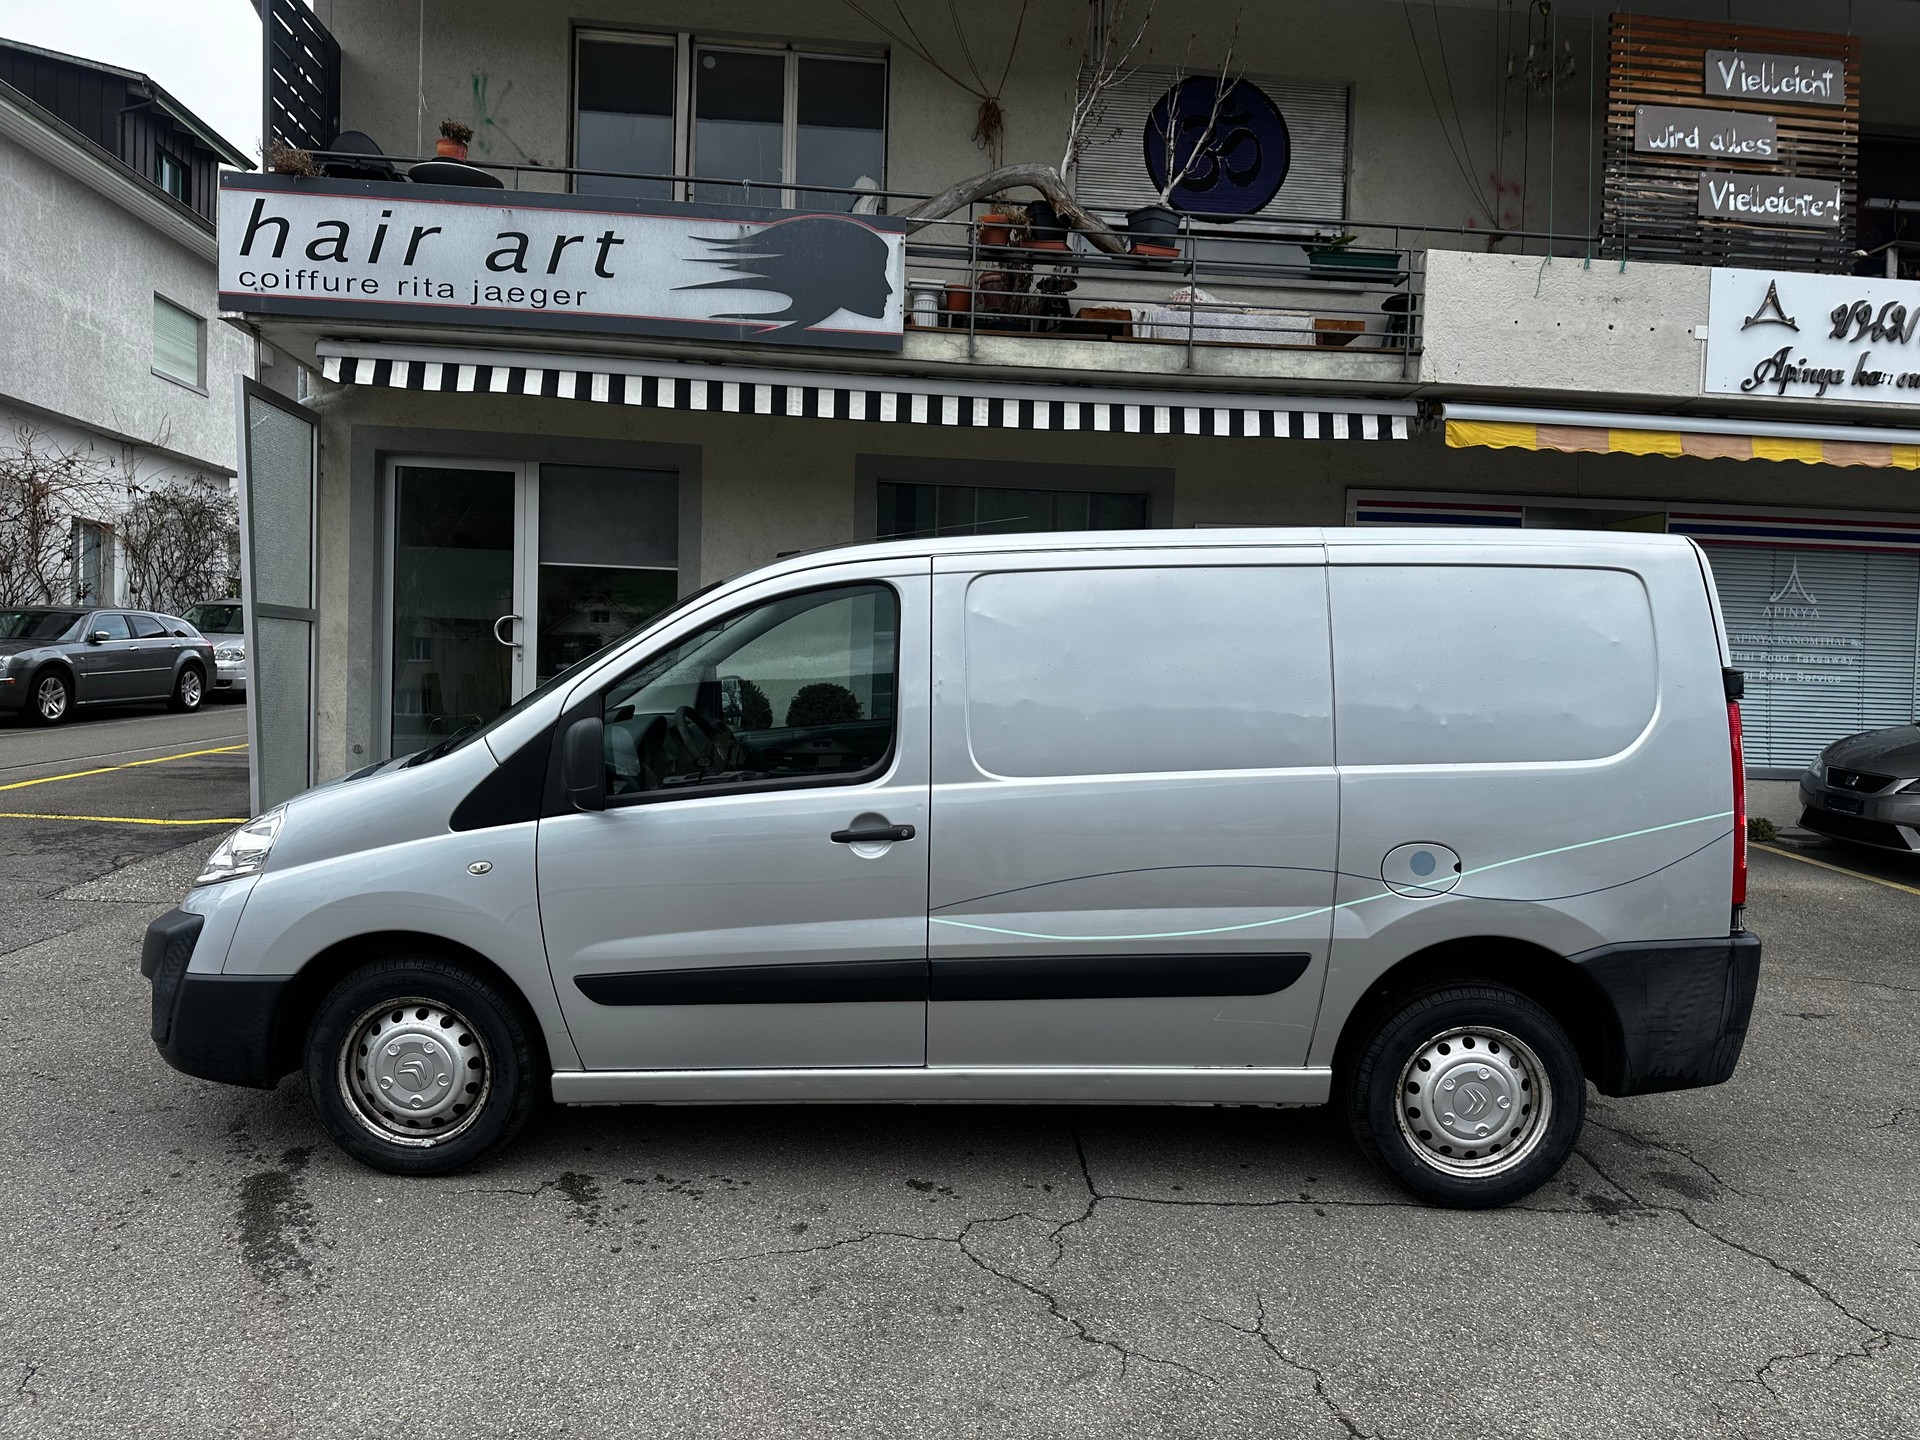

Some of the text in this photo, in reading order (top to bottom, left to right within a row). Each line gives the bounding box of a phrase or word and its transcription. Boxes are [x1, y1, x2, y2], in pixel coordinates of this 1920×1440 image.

[1717, 57, 1833, 98] Vielleicht
[1710, 128, 1771, 155] alles
[239, 198, 625, 279] hair art
[238, 268, 588, 309] coiffure rita jaeger
[1741, 345, 1845, 396] Apinya
[1762, 606, 1820, 619] APINYA
[1733, 634, 1774, 645] APINYA
[1760, 652, 1789, 663] Food
[1796, 653, 1854, 666] Takeaway
[1759, 671, 1791, 684] Party
[1796, 673, 1842, 684] Service
